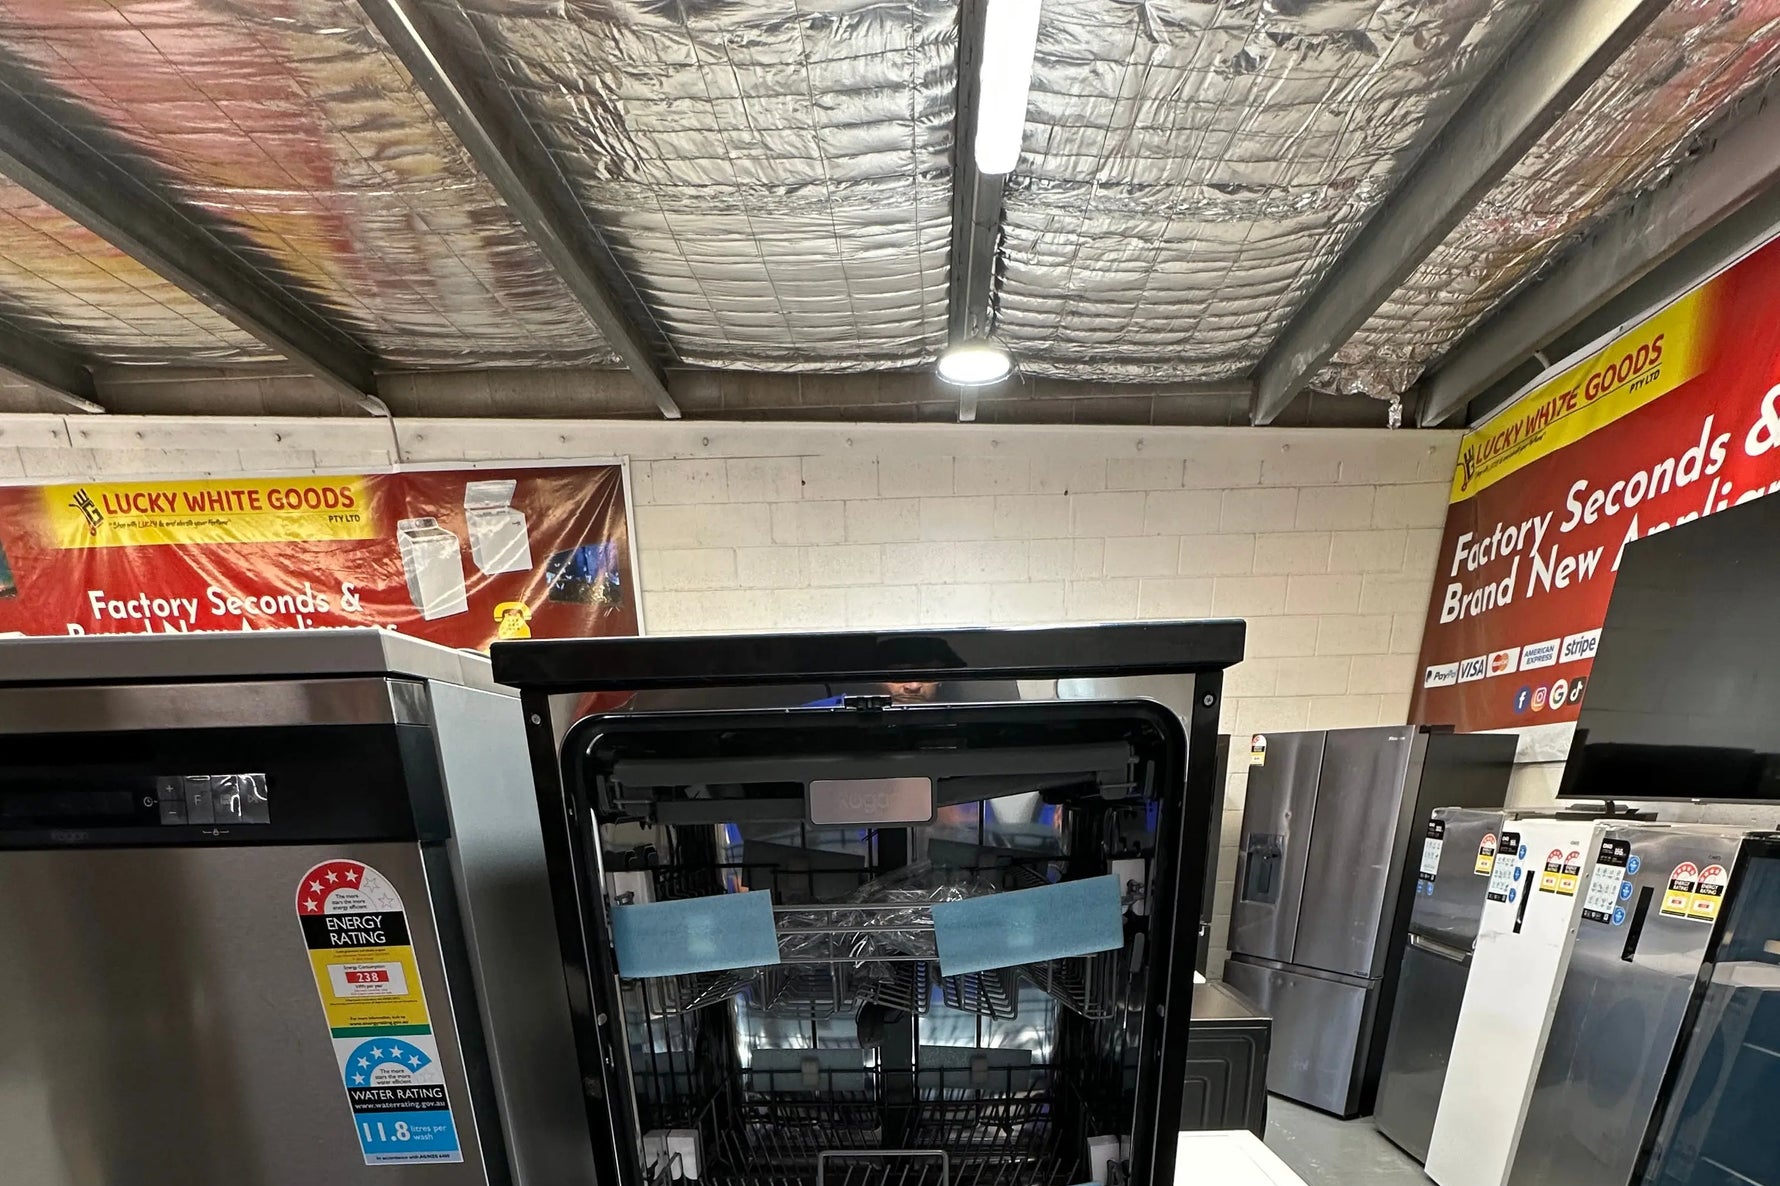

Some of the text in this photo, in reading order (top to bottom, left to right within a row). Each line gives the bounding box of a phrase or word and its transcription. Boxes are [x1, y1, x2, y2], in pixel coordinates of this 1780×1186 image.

[1629, 369, 1660, 395] PTY LTD
[1475, 421, 1524, 465] LUCKY
[1525, 386, 1578, 434] WHITE
[1584, 334, 1665, 401] GOODS
[1450, 510, 1554, 577] Factory
[1560, 414, 1731, 534] Seconds
[1744, 382, 1780, 458] &
[102, 486, 355, 515] LUCKY WHITE GOODS
[329, 513, 361, 524] PTY LTD
[1439, 543, 1604, 624] Brand New
[87, 582, 363, 624] Factory Seconds &
[1461, 659, 1484, 679] VISA
[1524, 645, 1554, 658] AMERICAN
[1564, 635, 1597, 657] stripe
[1526, 653, 1552, 665] EXPRESS
[326, 915, 383, 930] ENERGY
[330, 931, 386, 946] RATING
[356, 972, 379, 982] 238
[352, 1088, 443, 1100] WATER RATING
[355, 1100, 446, 1109] www.waterrating.gov.au
[362, 1121, 411, 1142] 11.8
[433, 1125, 447, 1133] per
